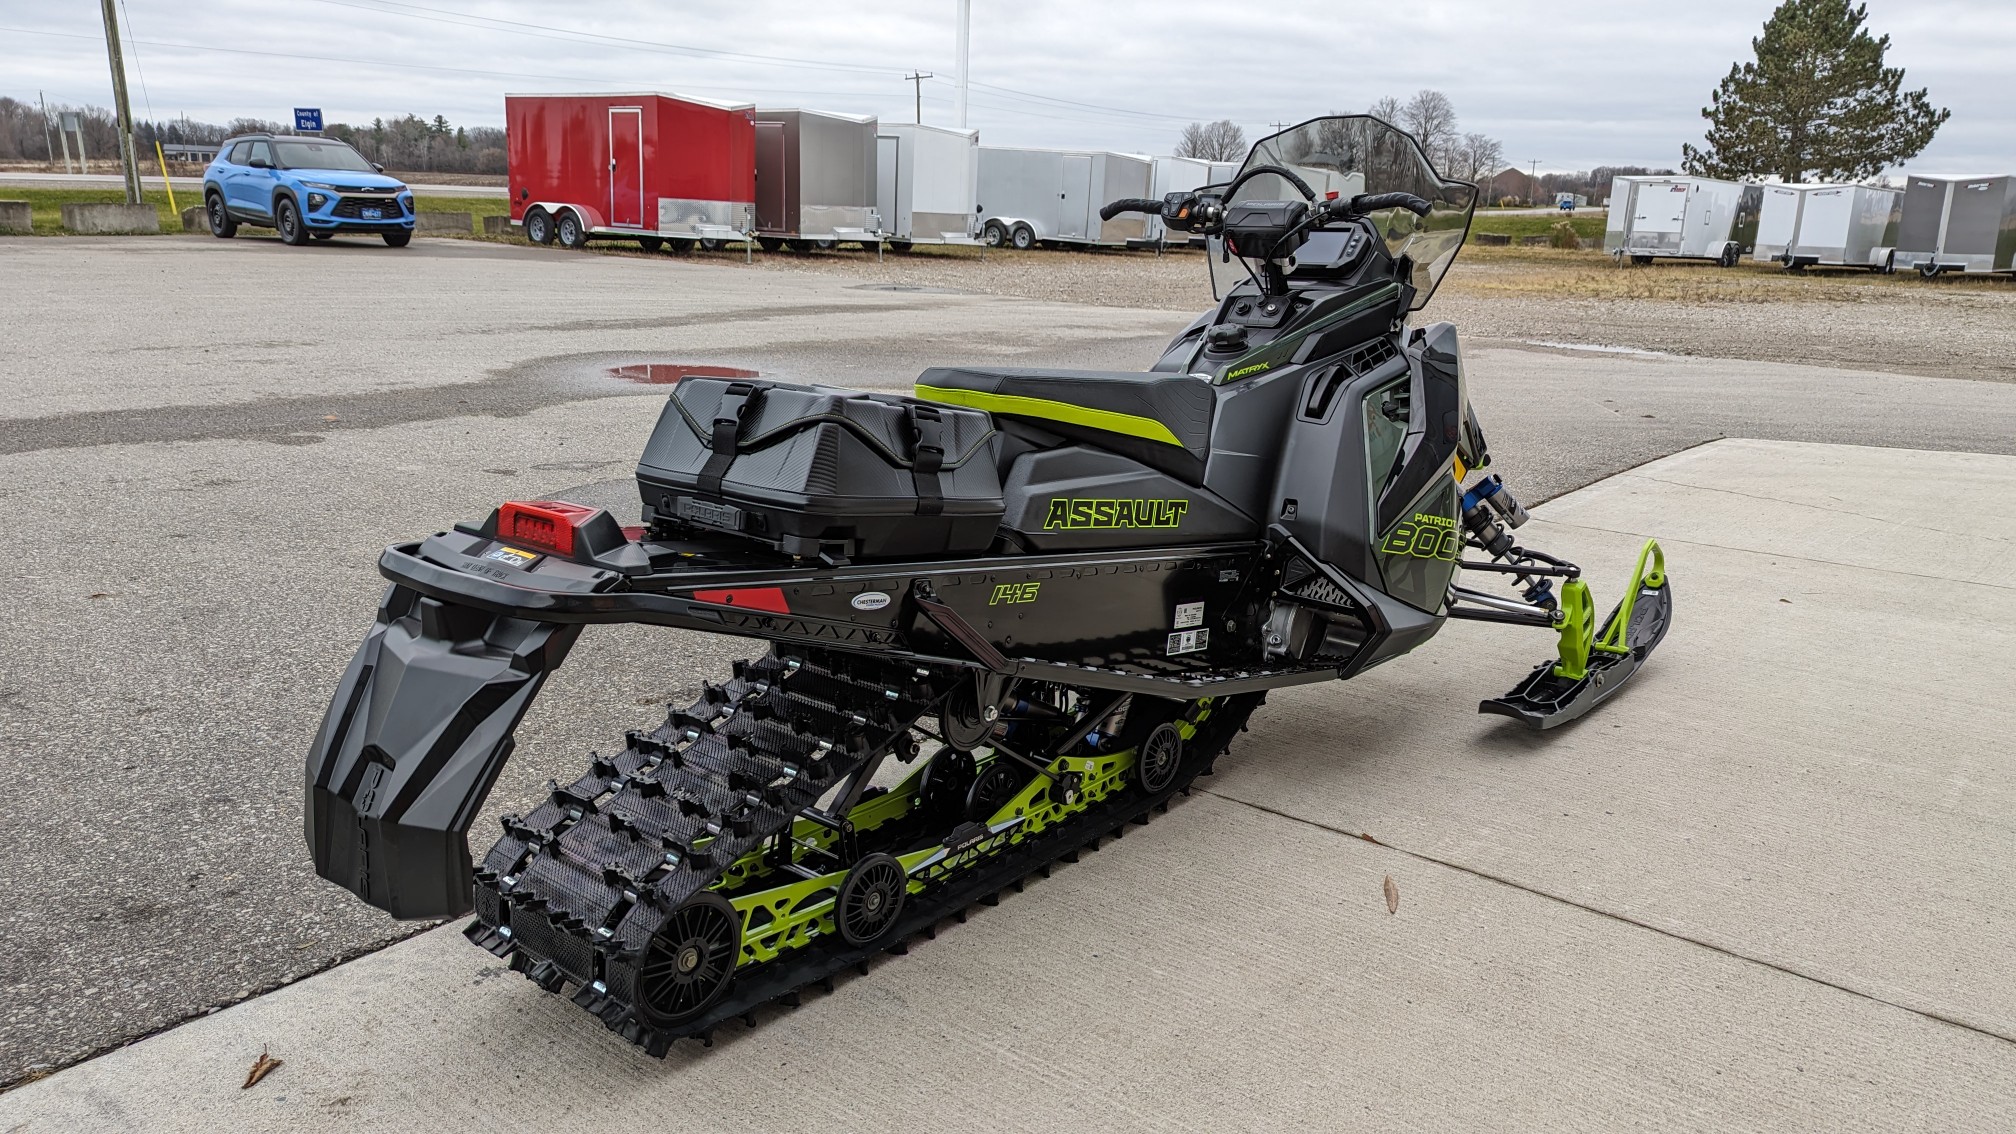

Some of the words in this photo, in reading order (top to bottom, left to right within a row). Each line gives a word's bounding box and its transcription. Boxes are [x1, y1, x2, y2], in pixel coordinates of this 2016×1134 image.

[301, 119, 317, 130] Elgin
[1227, 361, 1270, 381] MATRYX
[683, 503, 732, 522] POLARIS
[1043, 498, 1189, 530] ASSAULT
[1414, 512, 1457, 529] PATRIOT
[1381, 521, 1460, 562] 800
[856, 597, 888, 606] CHESTERMAN
[988, 582, 1041, 606] 146
[956, 833, 985, 851] POLARIS
